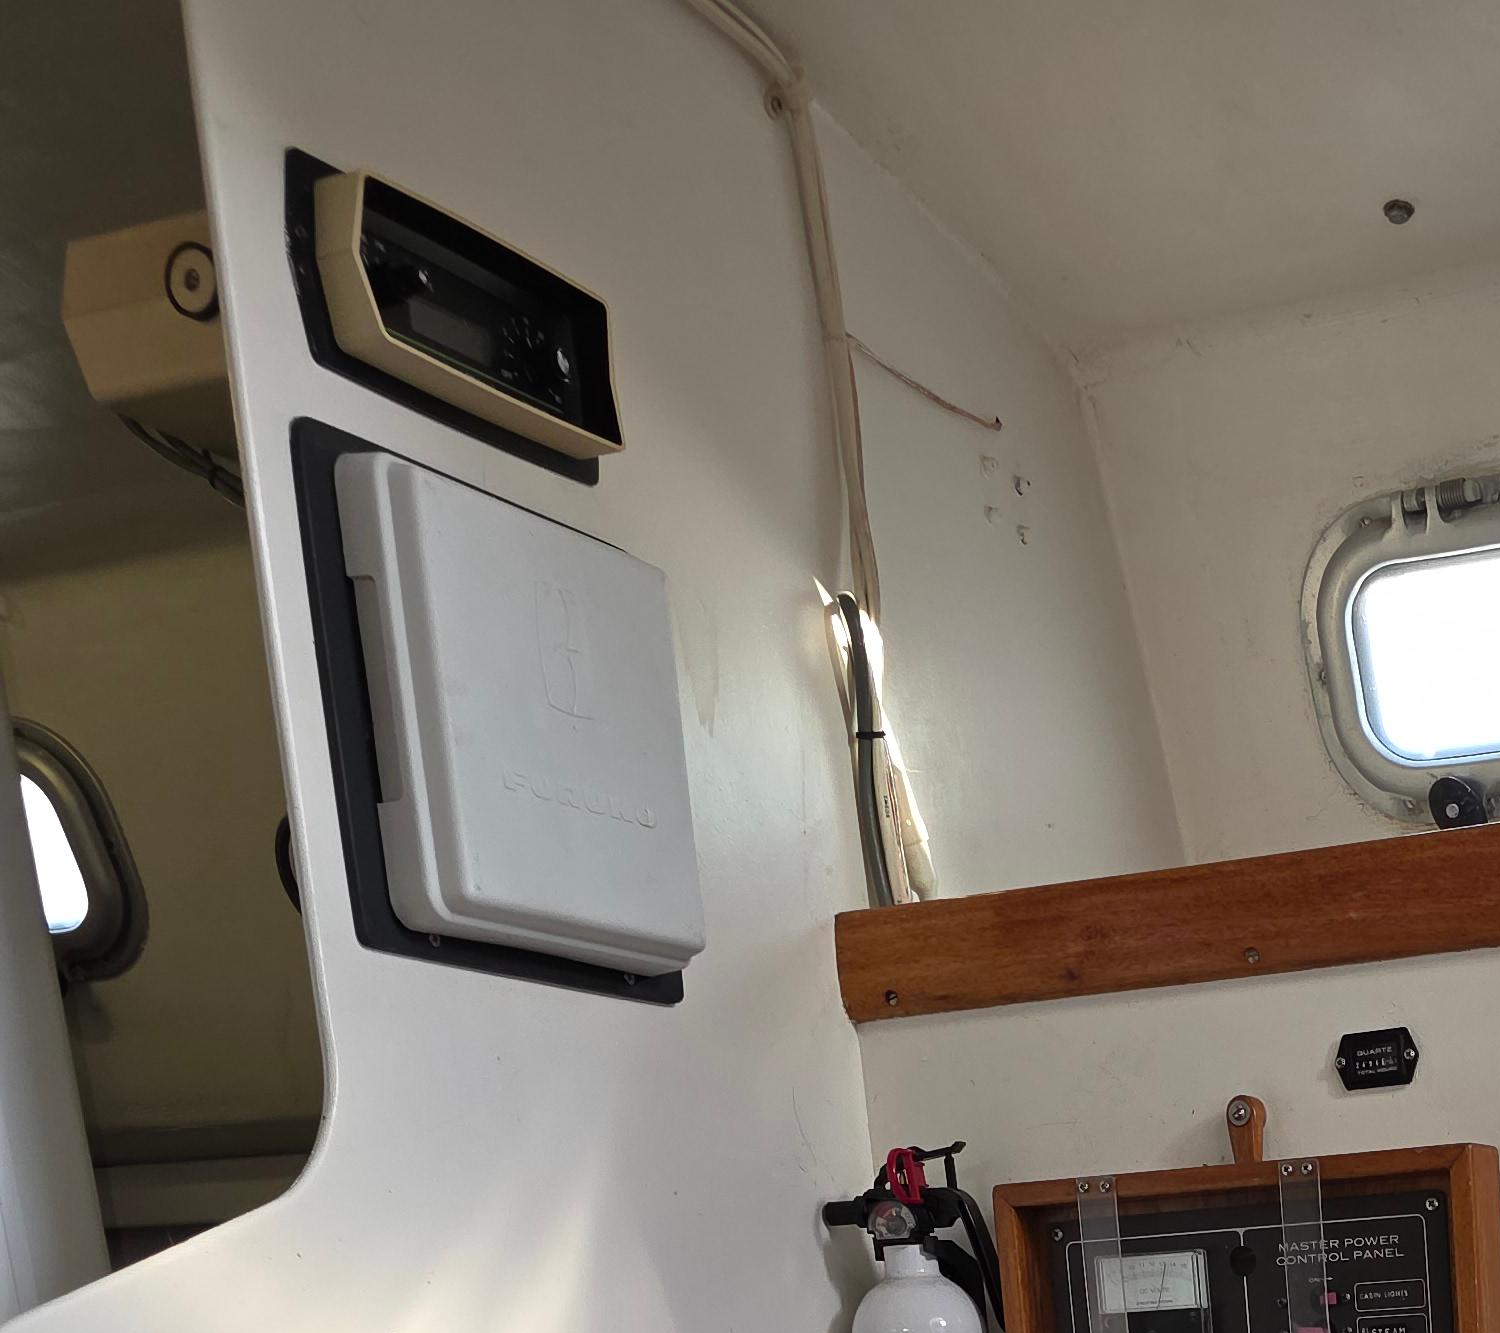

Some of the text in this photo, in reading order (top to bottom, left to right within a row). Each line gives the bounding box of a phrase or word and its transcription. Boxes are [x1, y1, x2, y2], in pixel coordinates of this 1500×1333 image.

[1278, 1235, 1400, 1252] MASTER POWER
[1276, 1248, 1405, 1266] CONTROL PANEL
